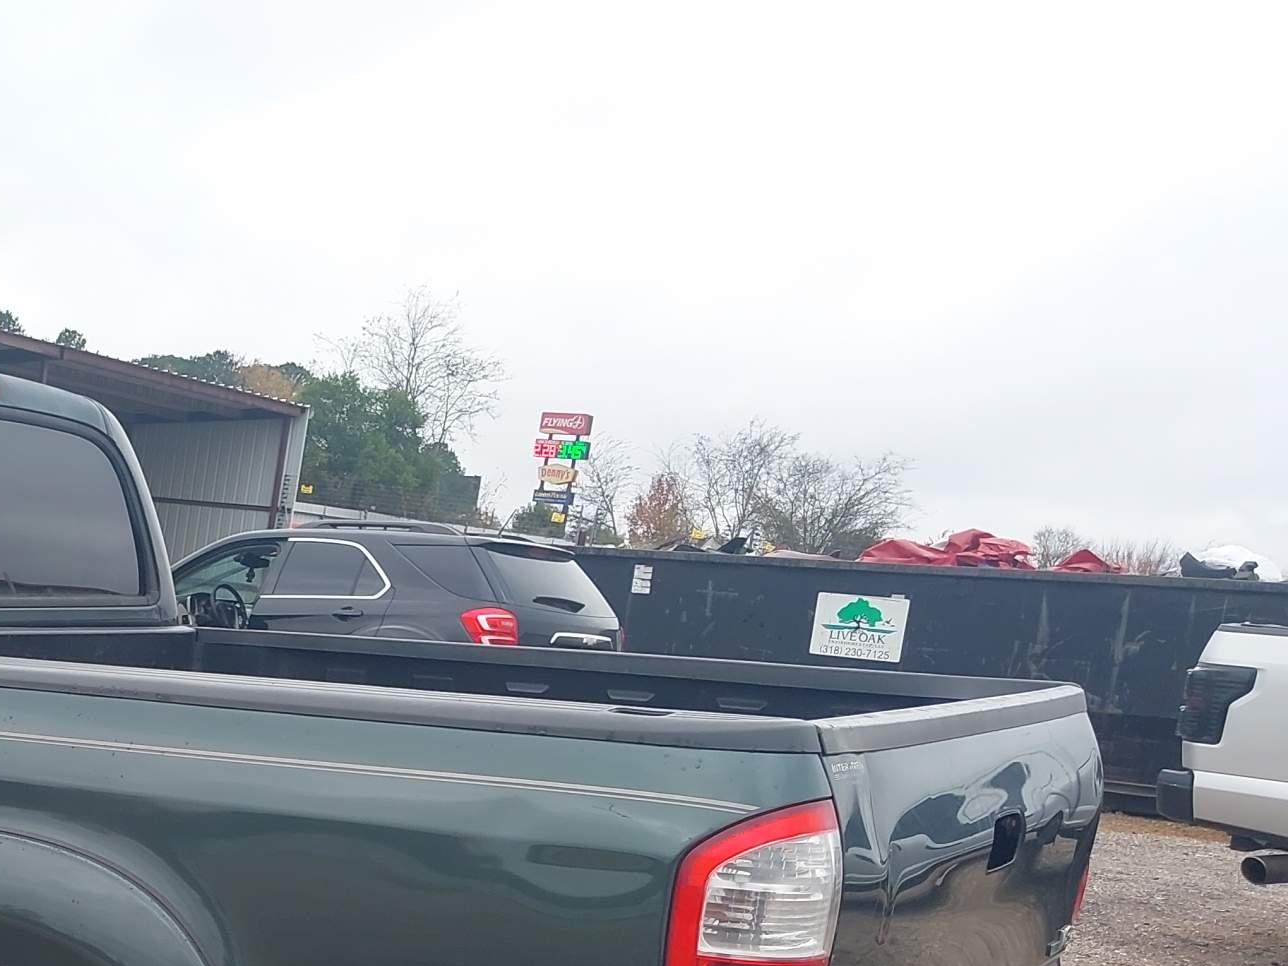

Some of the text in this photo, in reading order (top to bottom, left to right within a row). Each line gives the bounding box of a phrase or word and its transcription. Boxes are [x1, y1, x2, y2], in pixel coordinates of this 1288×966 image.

[542, 417, 573, 428] FLYING
[541, 468, 570, 480] Denny's
[819, 644, 890, 660] (318) 230-7125
